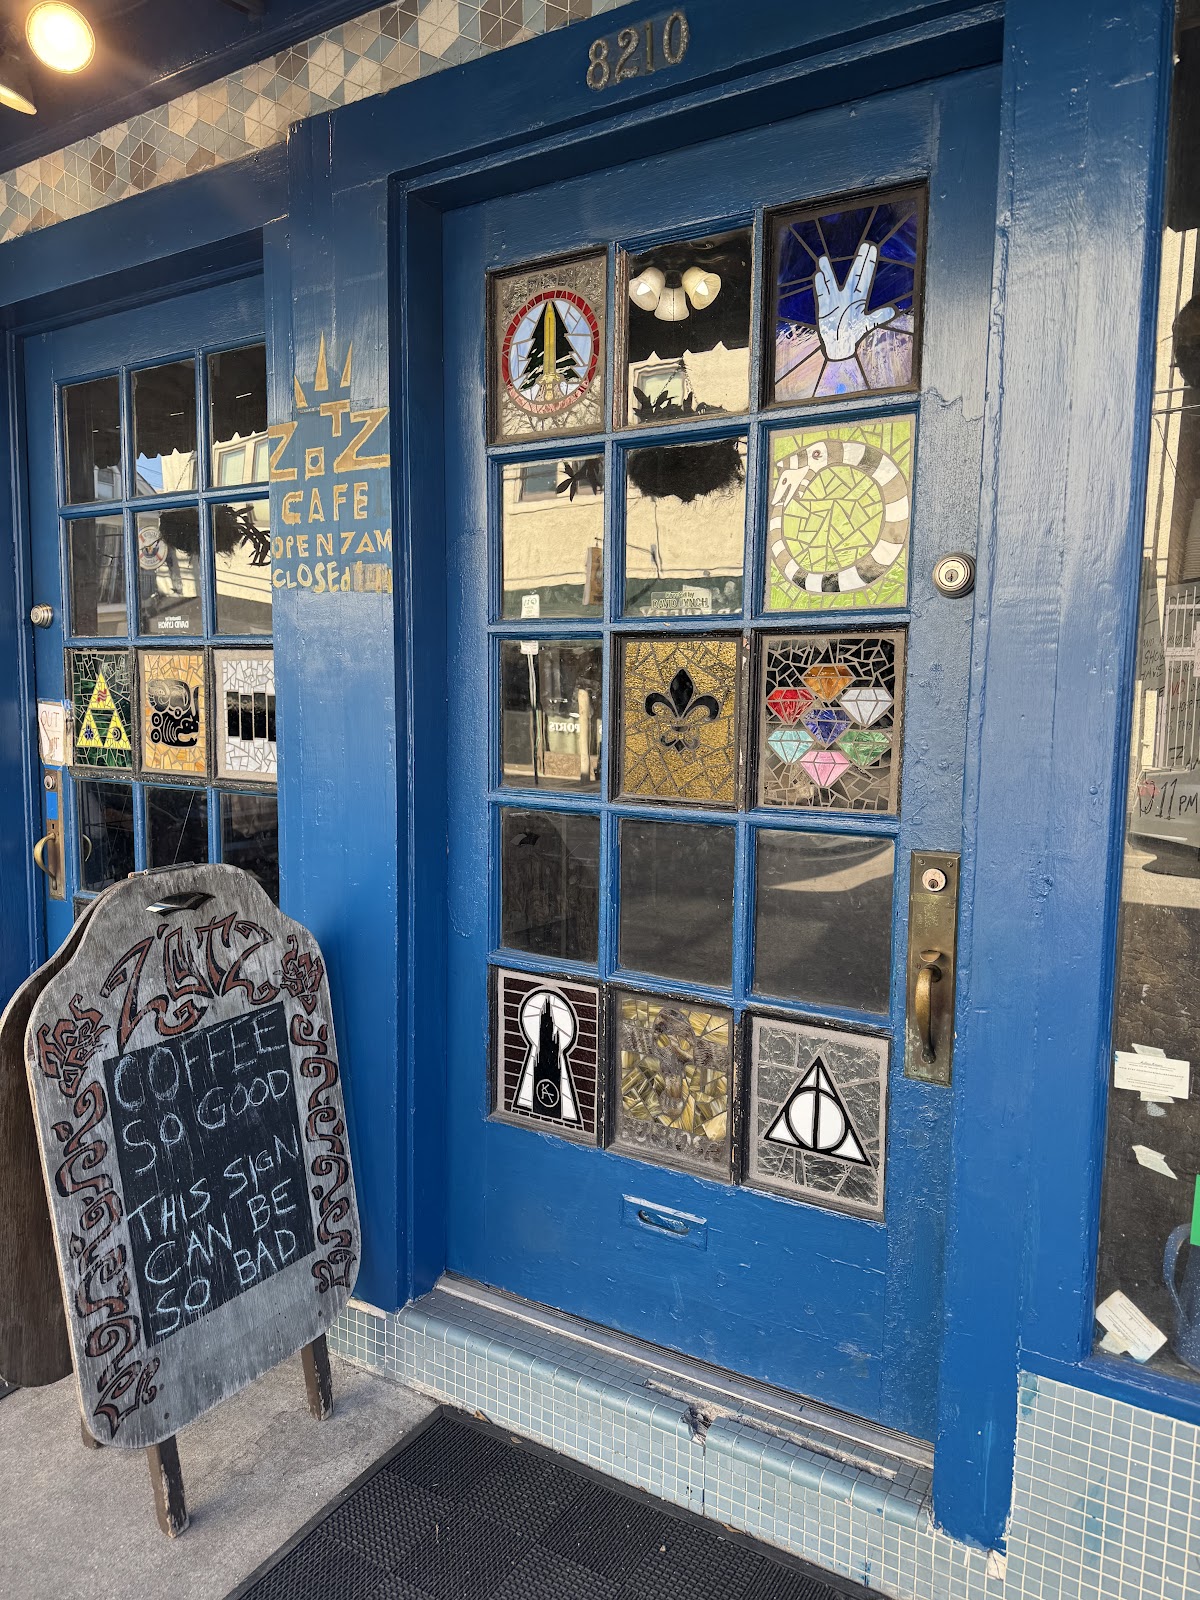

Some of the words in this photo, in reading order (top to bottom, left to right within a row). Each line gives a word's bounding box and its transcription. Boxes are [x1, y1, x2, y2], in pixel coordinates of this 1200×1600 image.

[587, 11, 689, 91] 8210
[271, 532, 333, 559] OPEN
[340, 528, 392, 555] 7AM
[281, 482, 369, 525] CAFE
[652, 598, 678, 609] DAVID
[1179, 792, 1199, 816] PM
[115, 1008, 287, 1111] COFFEE
[123, 1112, 185, 1175] SO
[198, 1069, 290, 1130] GOOD
[127, 1177, 211, 1242] THIS
[223, 1123, 300, 1200] SIGN
[145, 1212, 233, 1285] CAN
[247, 1178, 297, 1234] BE
[156, 1278, 211, 1335] SO
[233, 1229, 297, 1286] BAD
